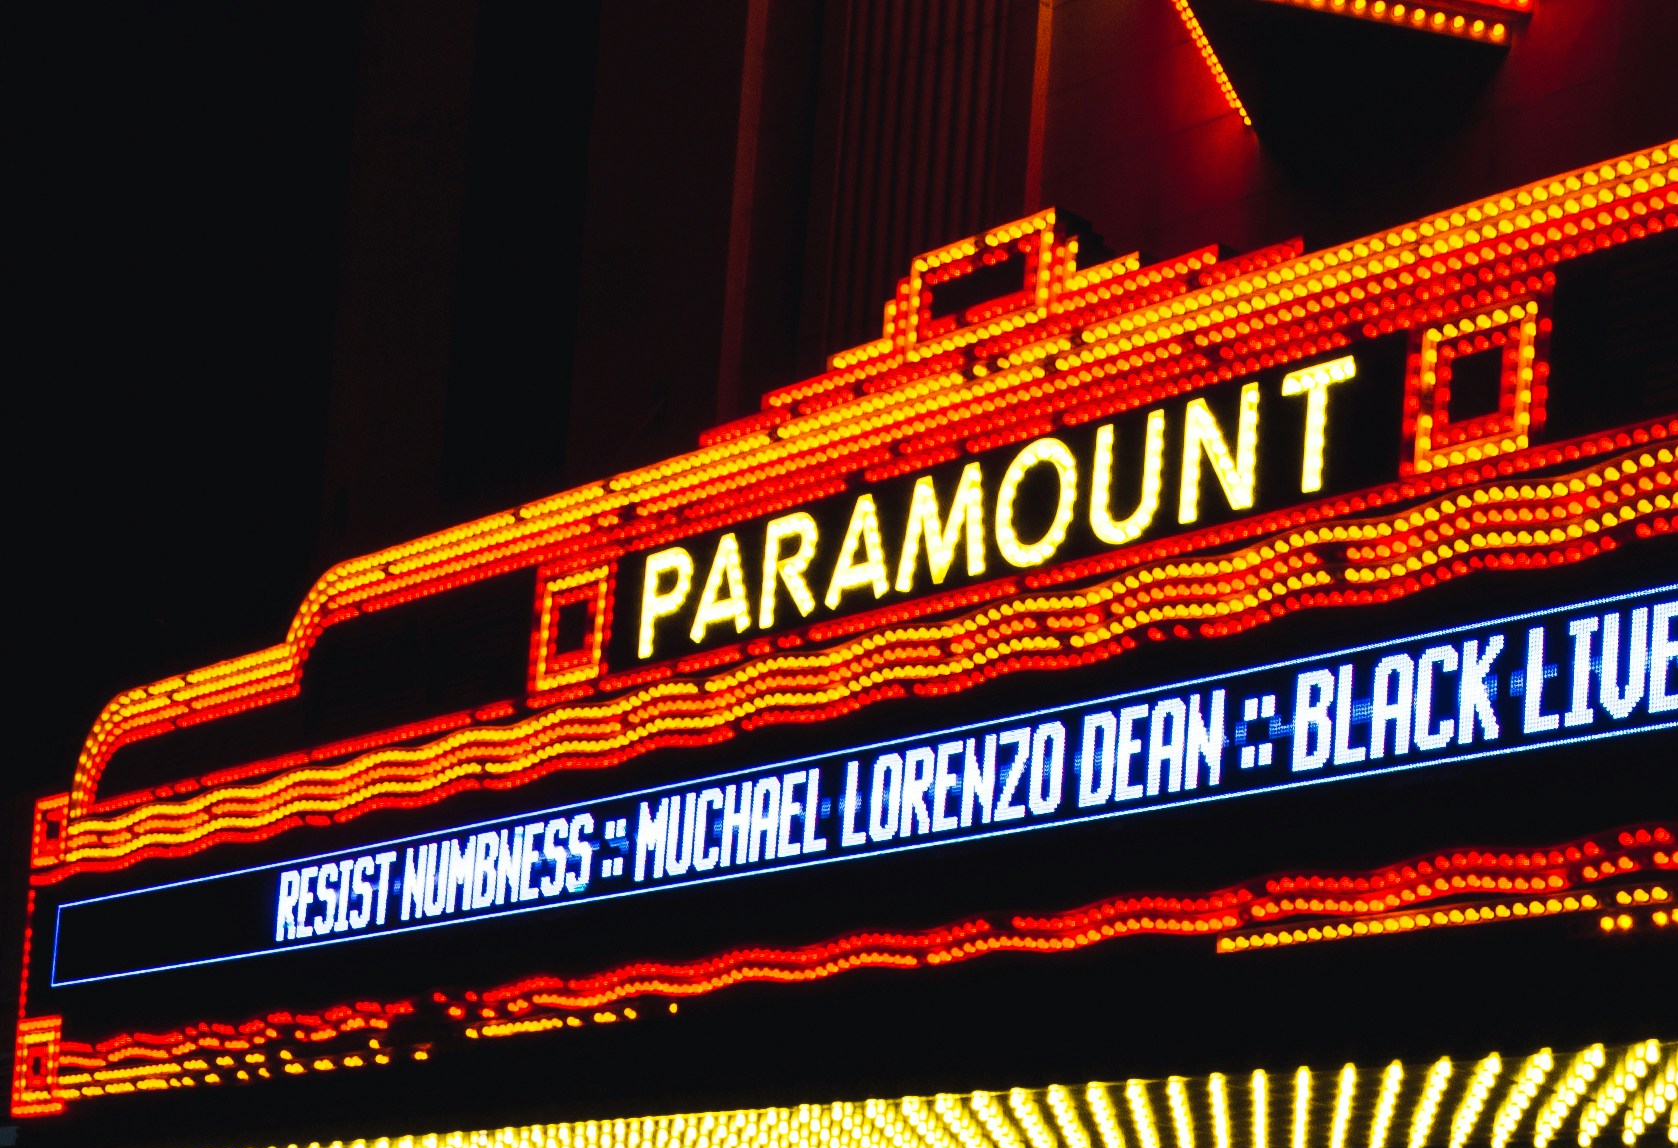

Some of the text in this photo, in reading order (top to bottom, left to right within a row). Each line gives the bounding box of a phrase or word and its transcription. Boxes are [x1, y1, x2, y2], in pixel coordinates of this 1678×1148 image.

[638, 354, 1357, 660] PARAMOUNT
[275, 850, 399, 942] RESIST
[400, 812, 600, 921] NUMBNESS
[633, 767, 828, 883] MUCHAEL
[839, 713, 1066, 847] LORENZO
[1075, 688, 1230, 809] DEAN
[1291, 634, 1506, 772] BLACK
